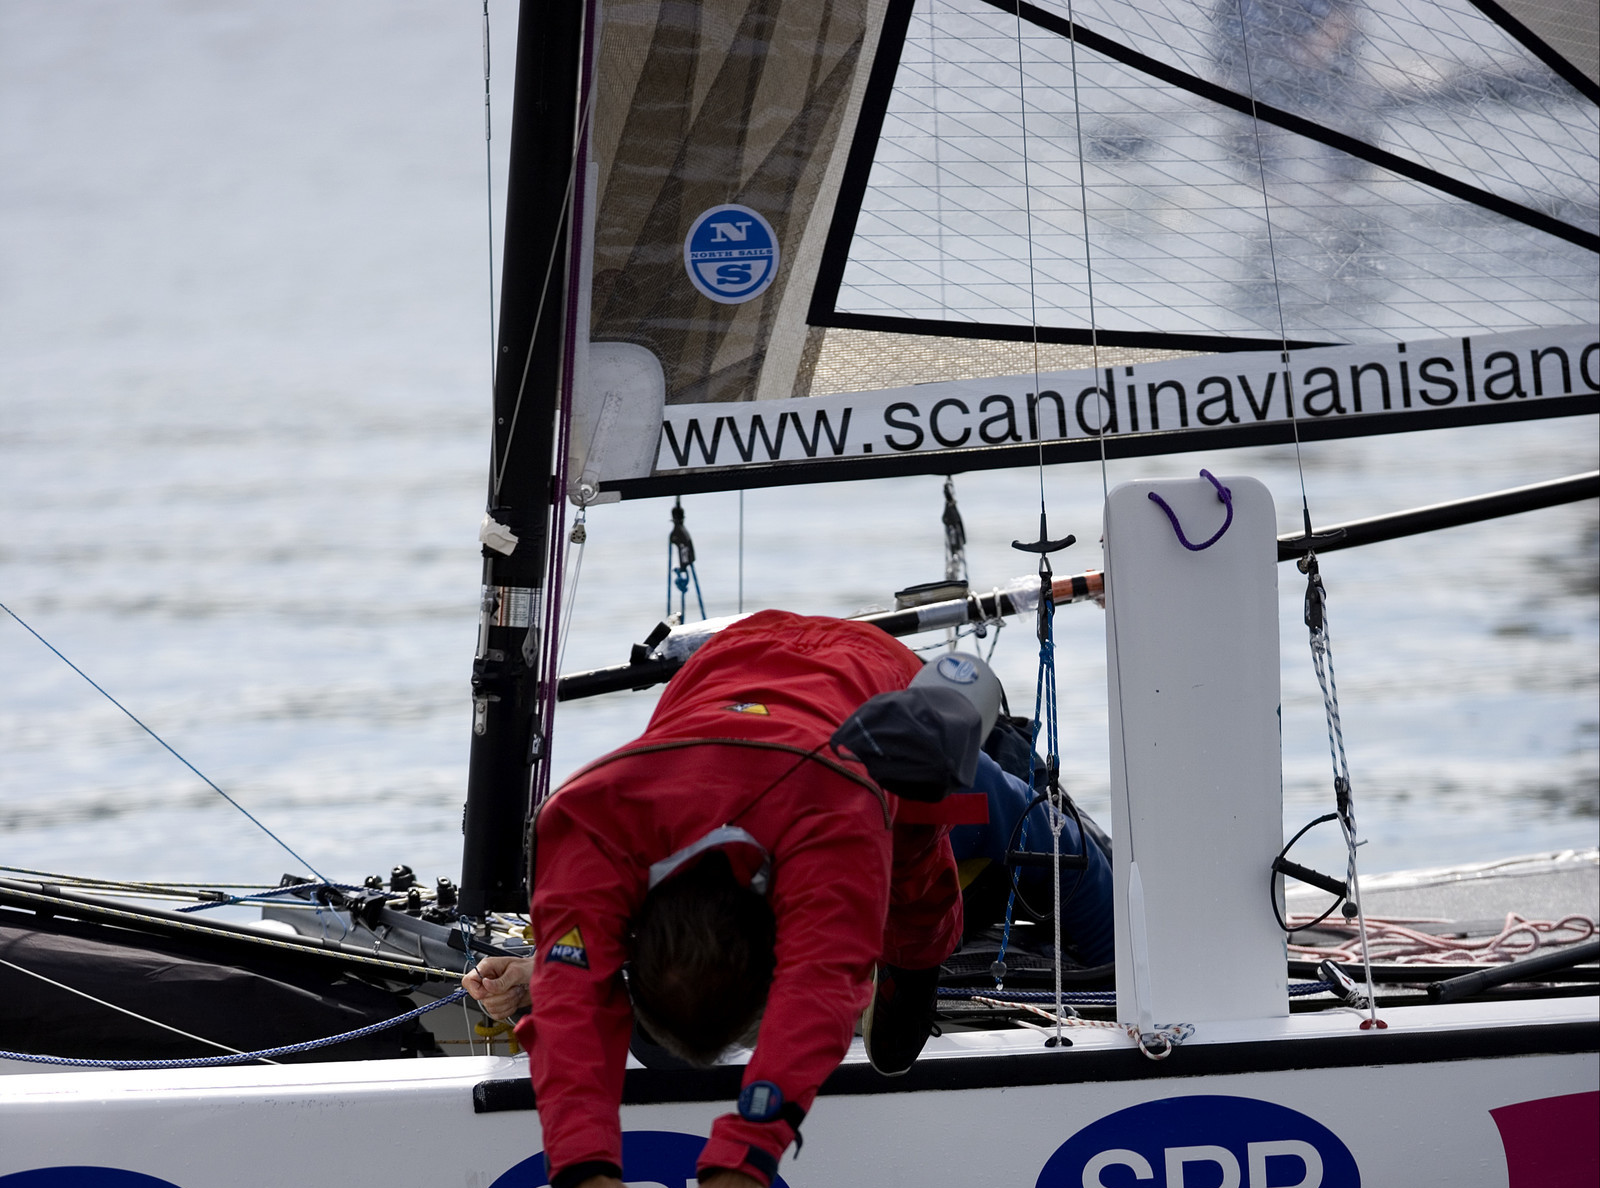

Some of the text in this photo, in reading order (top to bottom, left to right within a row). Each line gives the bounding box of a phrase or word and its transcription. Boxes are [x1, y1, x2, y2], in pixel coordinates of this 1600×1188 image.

[709, 221, 753, 243] N
[690, 248, 774, 259] NORTH SAILS
[715, 263, 752, 285] S
[551, 944, 584, 961] HPX
